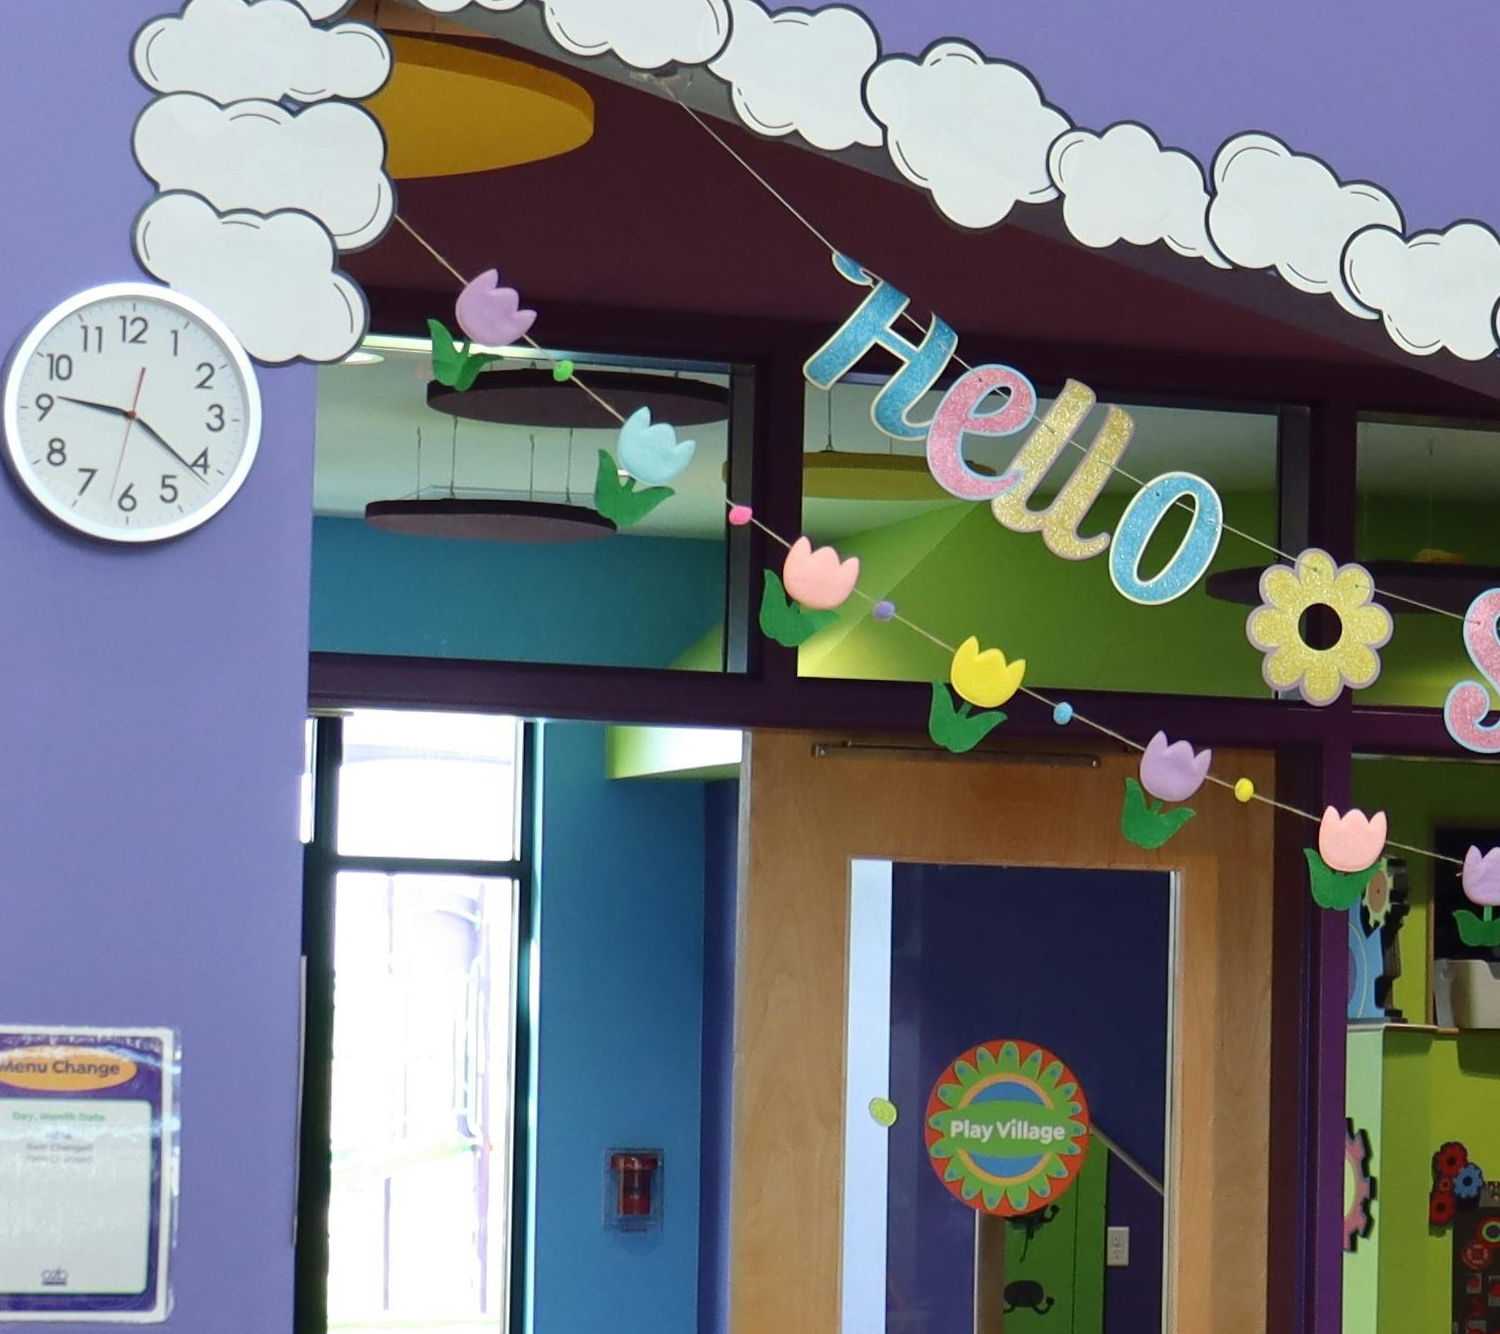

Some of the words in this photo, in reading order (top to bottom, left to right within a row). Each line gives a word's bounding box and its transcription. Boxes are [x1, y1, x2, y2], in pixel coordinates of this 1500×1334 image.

[81, 325, 104, 354] 11
[119, 316, 148, 344] 12
[170, 330, 179, 357] 1
[47, 353, 73, 381] 10
[194, 363, 215, 390] 2
[36, 393, 55, 422] 9
[205, 404, 225, 433] 3
[47, 438, 67, 466] 8
[191, 447, 210, 475] 4
[77, 468, 97, 497] 7
[159, 475, 179, 504] 5
[117, 483, 138, 513] 6
[52, 1061, 121, 1078] Change
[950, 1119, 993, 1143] Play
[997, 1121, 1066, 1144] Village
